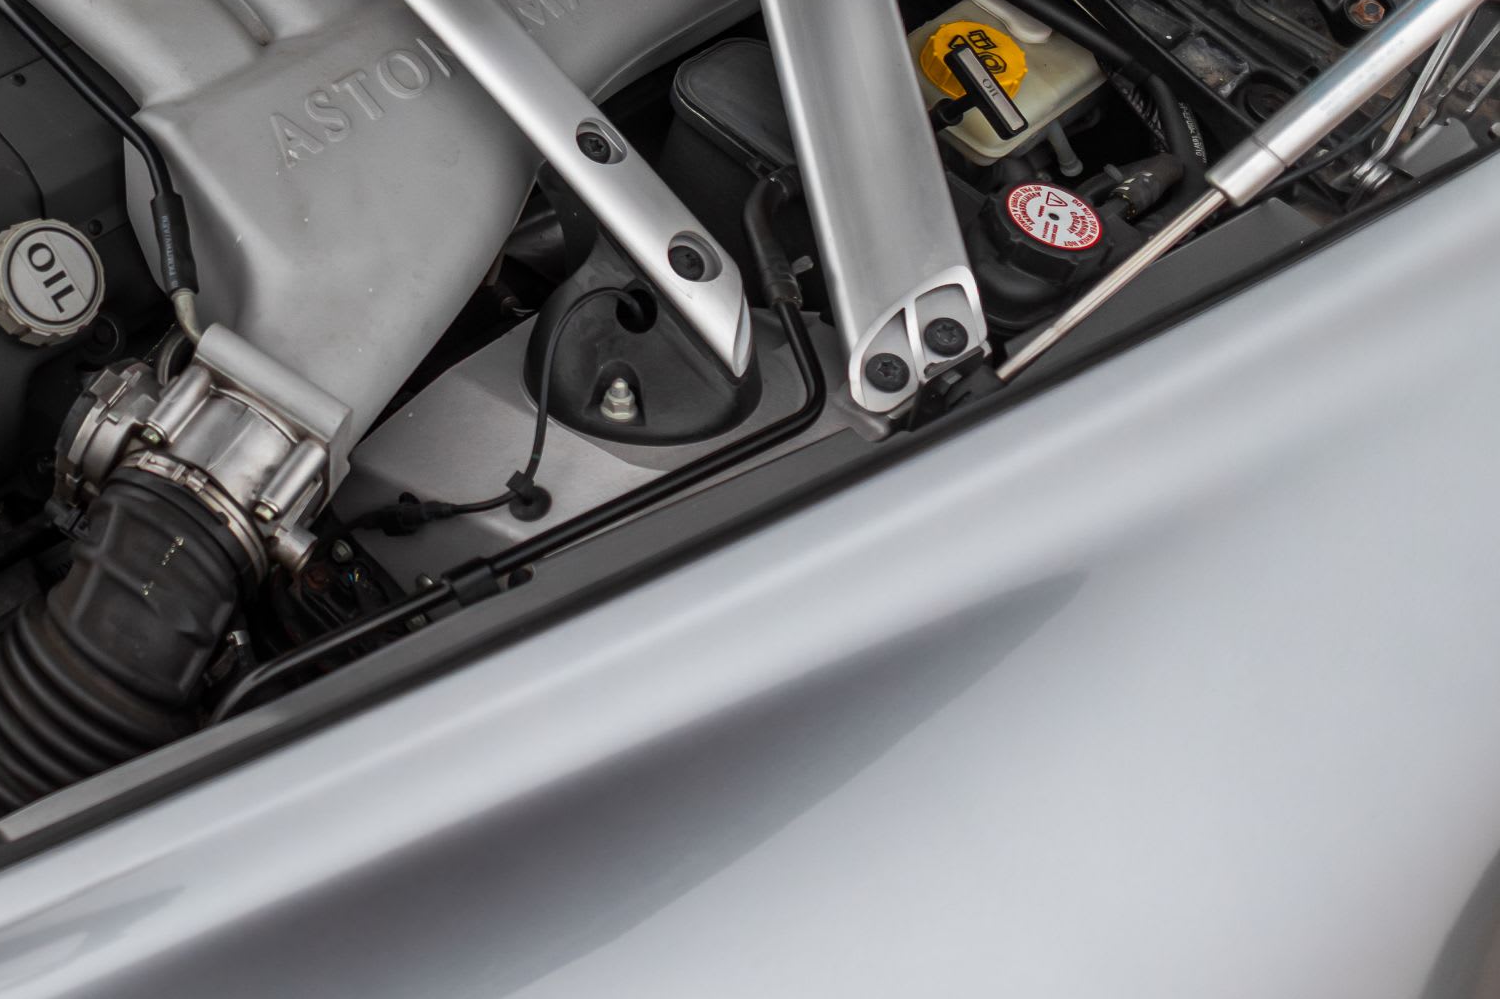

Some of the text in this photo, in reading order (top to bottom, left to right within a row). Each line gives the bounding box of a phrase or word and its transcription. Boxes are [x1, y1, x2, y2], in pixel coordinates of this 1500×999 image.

[1081, 205, 1093, 218] NOT
[1013, 212, 1033, 231] CHAUD
[27, 242, 75, 314] OIL
